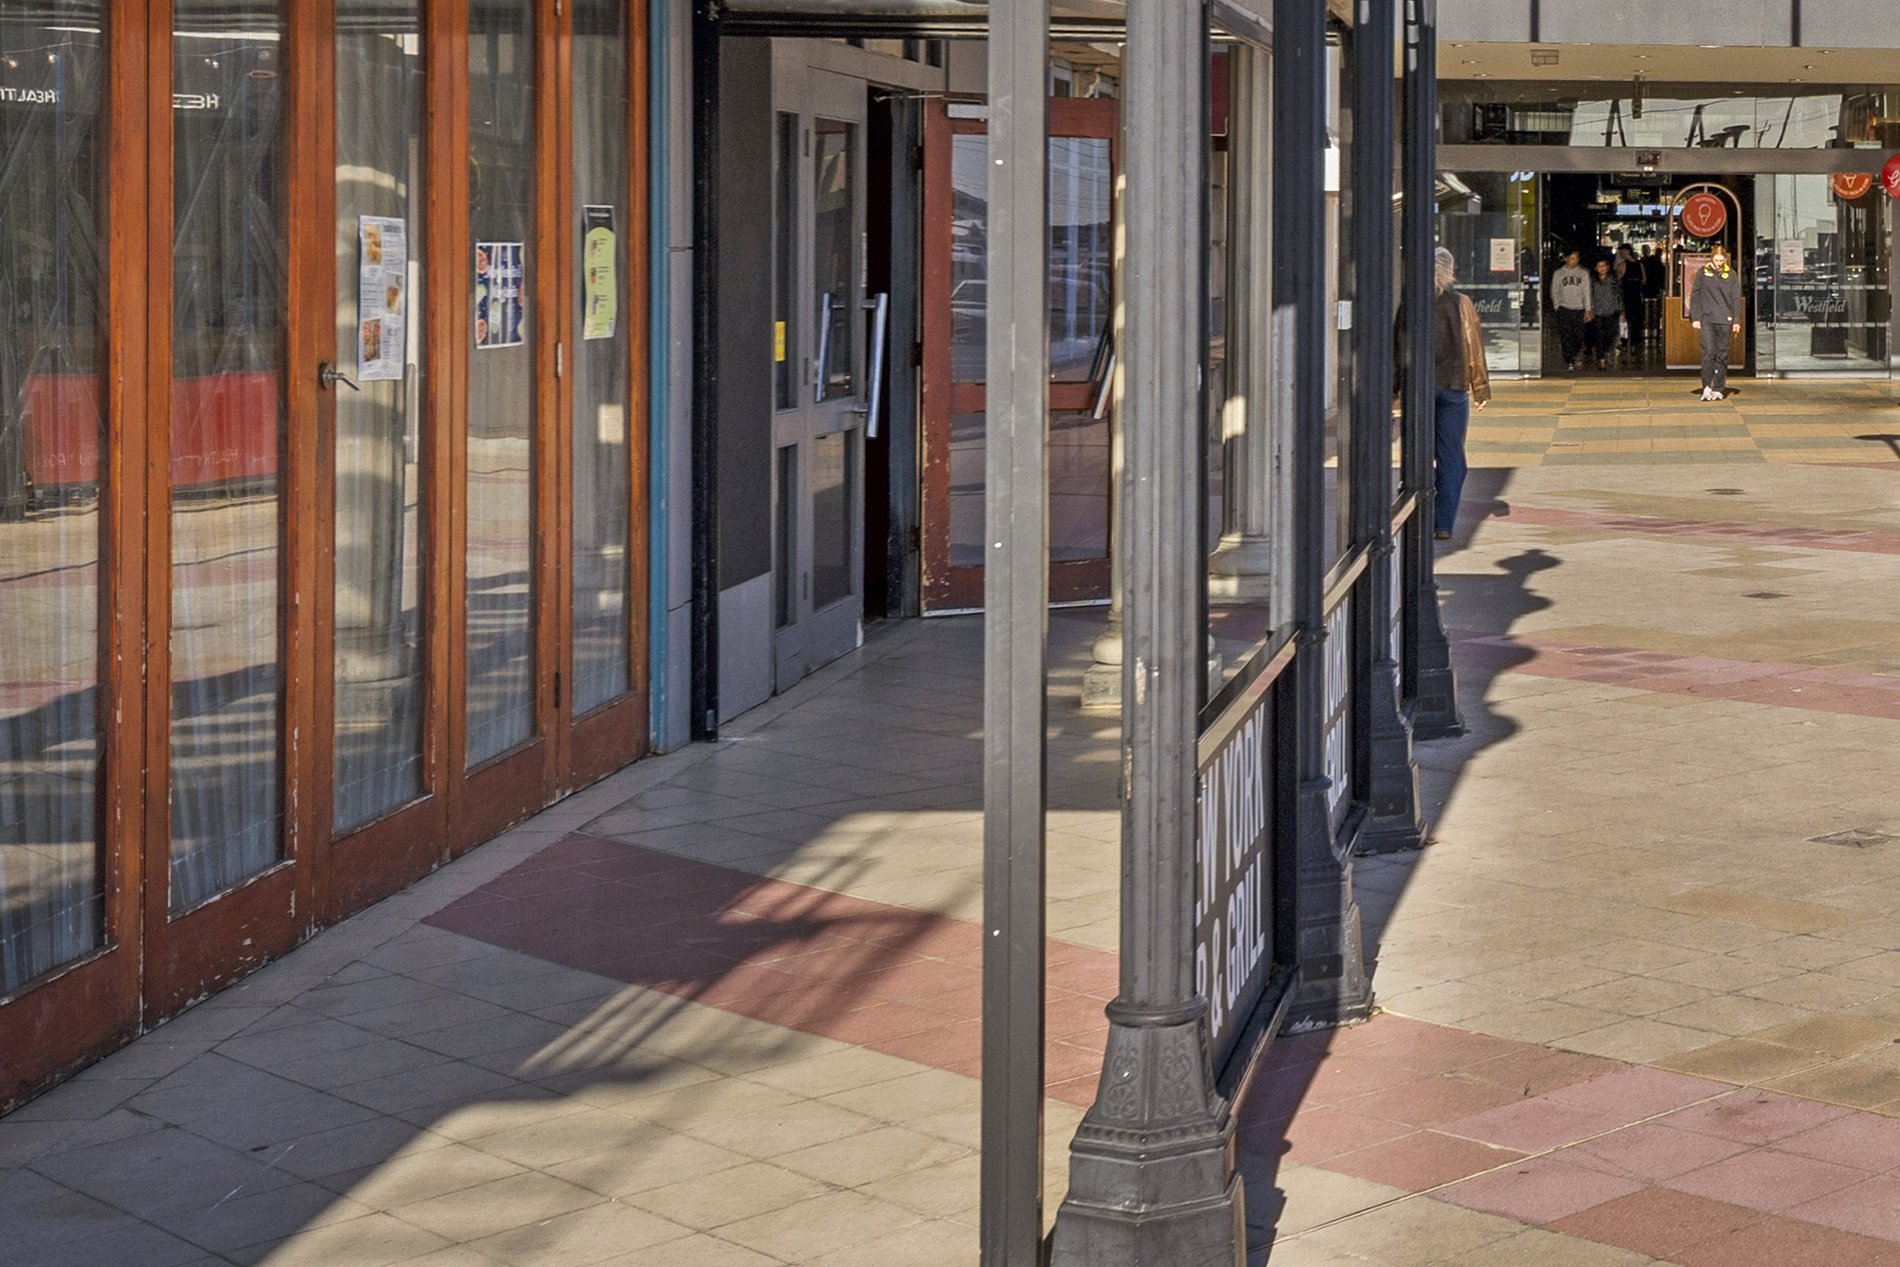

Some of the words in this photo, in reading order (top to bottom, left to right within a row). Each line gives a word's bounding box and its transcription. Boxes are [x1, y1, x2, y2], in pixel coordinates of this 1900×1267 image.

[1562, 275, 1583, 287] GAP
[1474, 299, 1503, 313] tfield
[1792, 295, 1847, 313] Westfield
[1223, 702, 1265, 883] YORK
[1226, 851, 1266, 1012] GRILL
